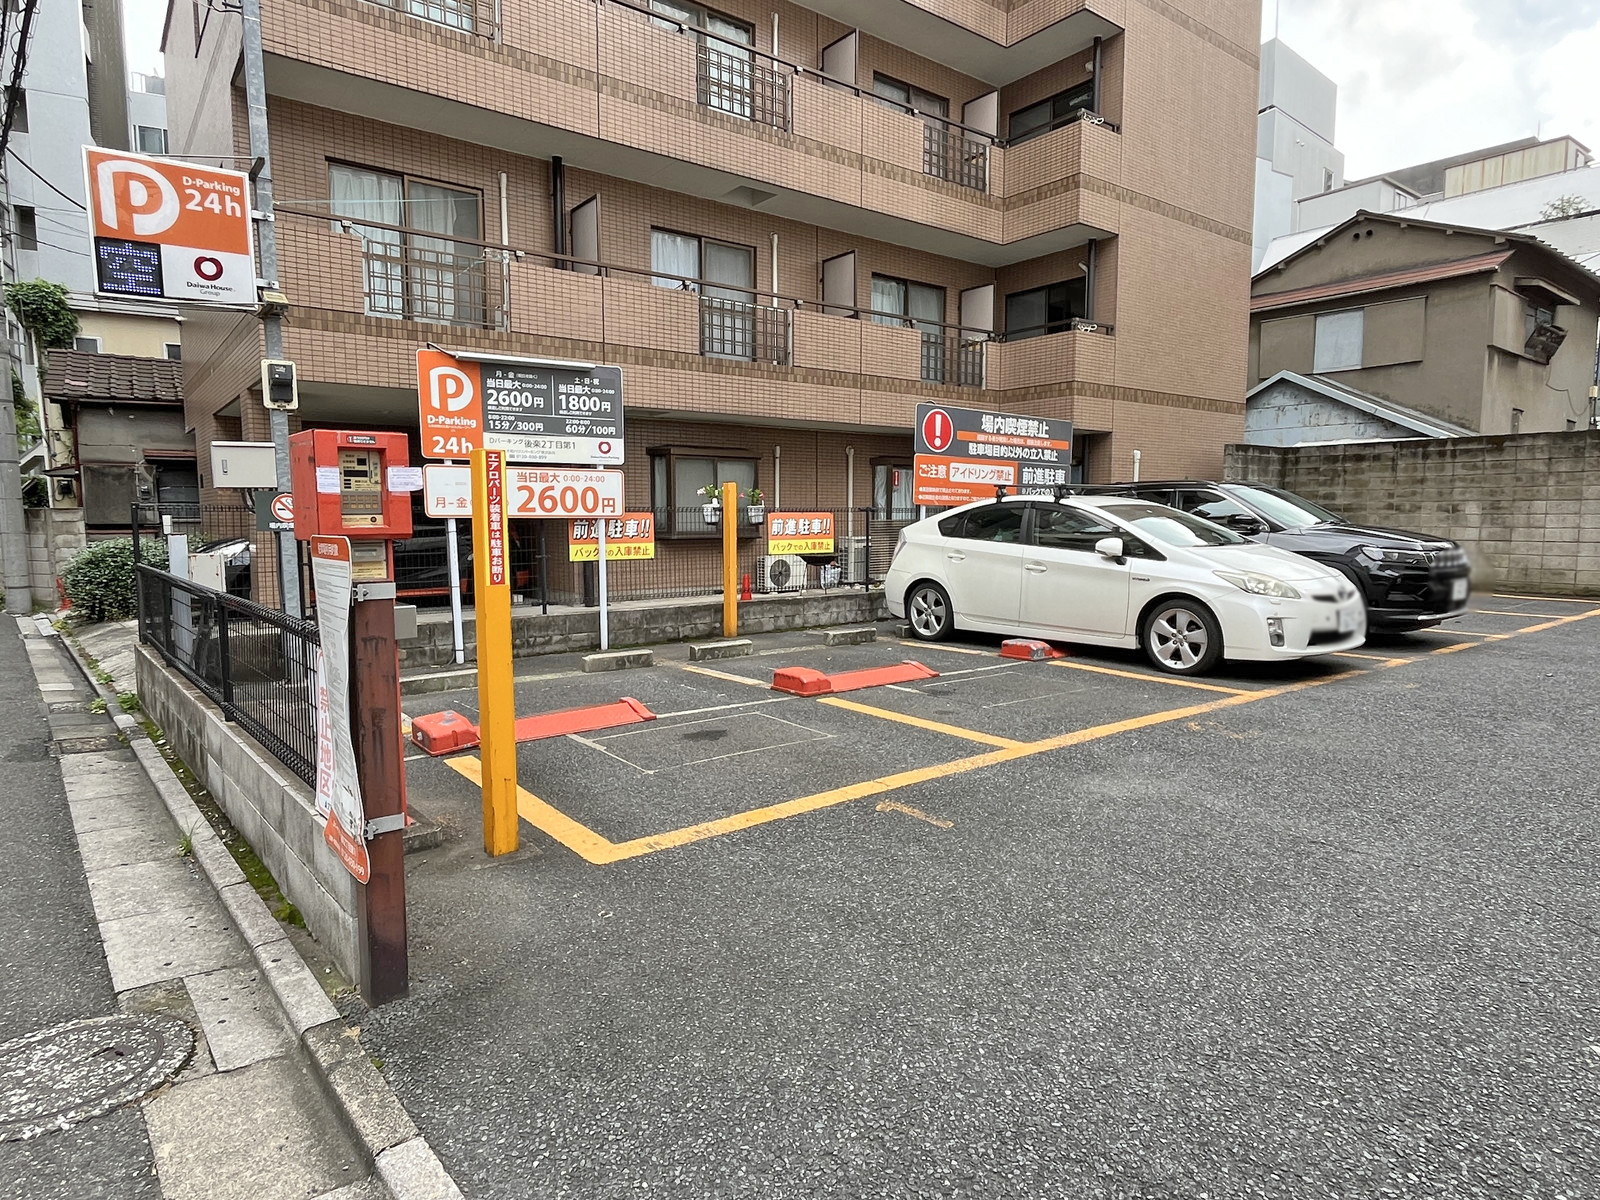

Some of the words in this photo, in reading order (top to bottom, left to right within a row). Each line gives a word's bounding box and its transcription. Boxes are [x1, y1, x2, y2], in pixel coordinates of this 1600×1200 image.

[182, 176, 241, 197] D-Parking
[184, 188, 242, 218] 24h
[100, 243, 161, 294] 空
[186, 281, 210, 290] Daiwa
[210, 284, 233, 292] House
[200, 289, 221, 297] Group
[486, 378, 521, 389] 当日最大
[558, 383, 591, 395] 当日最大
[487, 389, 544, 408] 2600円
[558, 394, 611, 413] 1800円
[427, 414, 477, 429] D-Parking
[488, 420, 544, 432] 15分/300円
[981, 414, 1050, 439] 場内喫煙禁止
[565, 424, 616, 436] 60分/100円
[432, 435, 474, 455] 24h
[968, 442, 1059, 462] 駐車場目的以外の立入禁止
[516, 472, 560, 484] 当日最大
[563, 474, 606, 483] 0:00-24:00
[919, 464, 947, 479] ご注意
[951, 466, 1013, 482] アイドリング禁止
[1022, 466, 1067, 486] 前進駐車
[516, 485, 616, 514] 2600円
[771, 518, 831, 536] 前進駐車!!
[574, 545, 651, 558] バックの入庫禁止
[772, 541, 831, 552] バックでの入庫禁止
